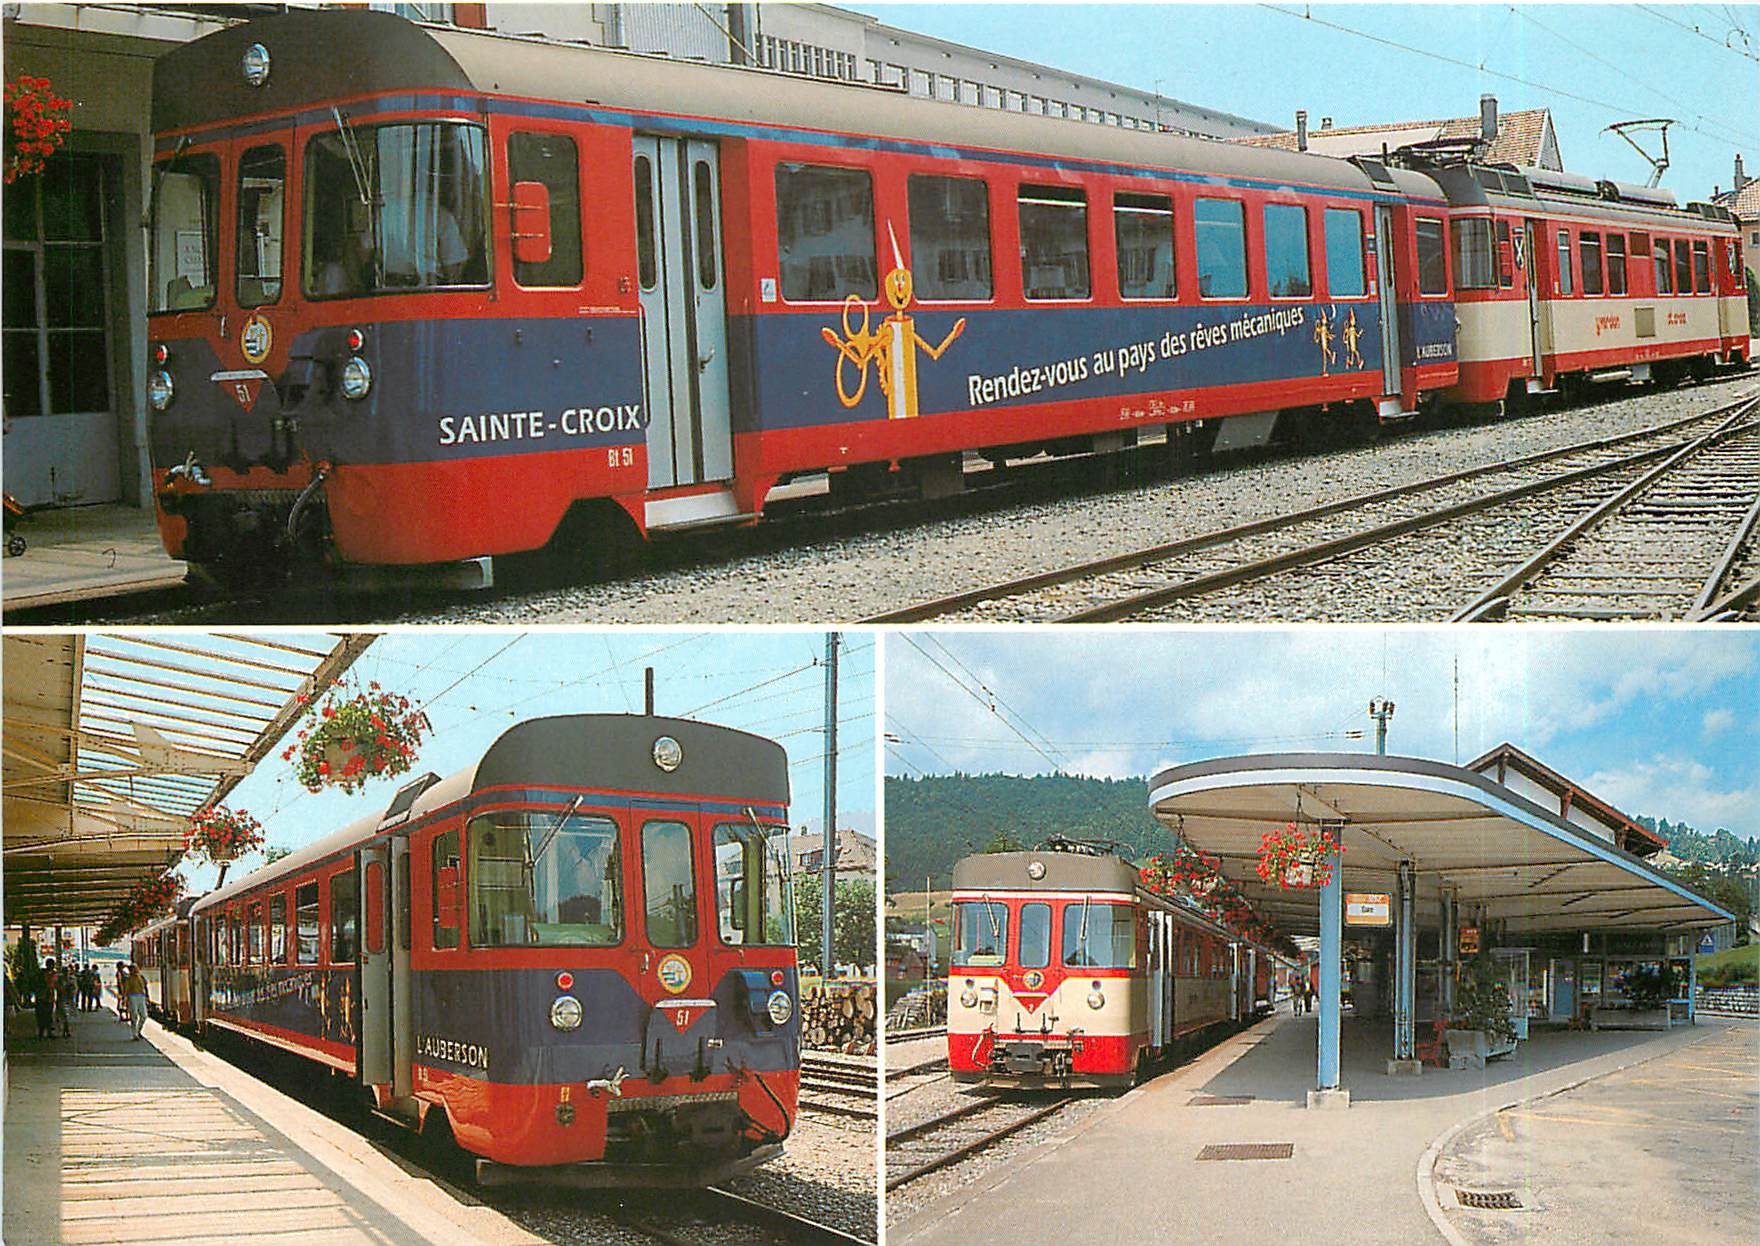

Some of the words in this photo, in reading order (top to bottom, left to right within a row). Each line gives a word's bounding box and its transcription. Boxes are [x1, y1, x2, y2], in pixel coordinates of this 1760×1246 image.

[968, 357, 1088, 406] Rendez-vous
[1093, 349, 1115, 375] au
[1119, 340, 1156, 377] pays
[1160, 332, 1187, 359] des
[1190, 323, 1227, 351] rêves
[1230, 306, 1305, 342] mécaniques
[235, 384, 251, 402] 51
[622, 448, 634, 467] 51
